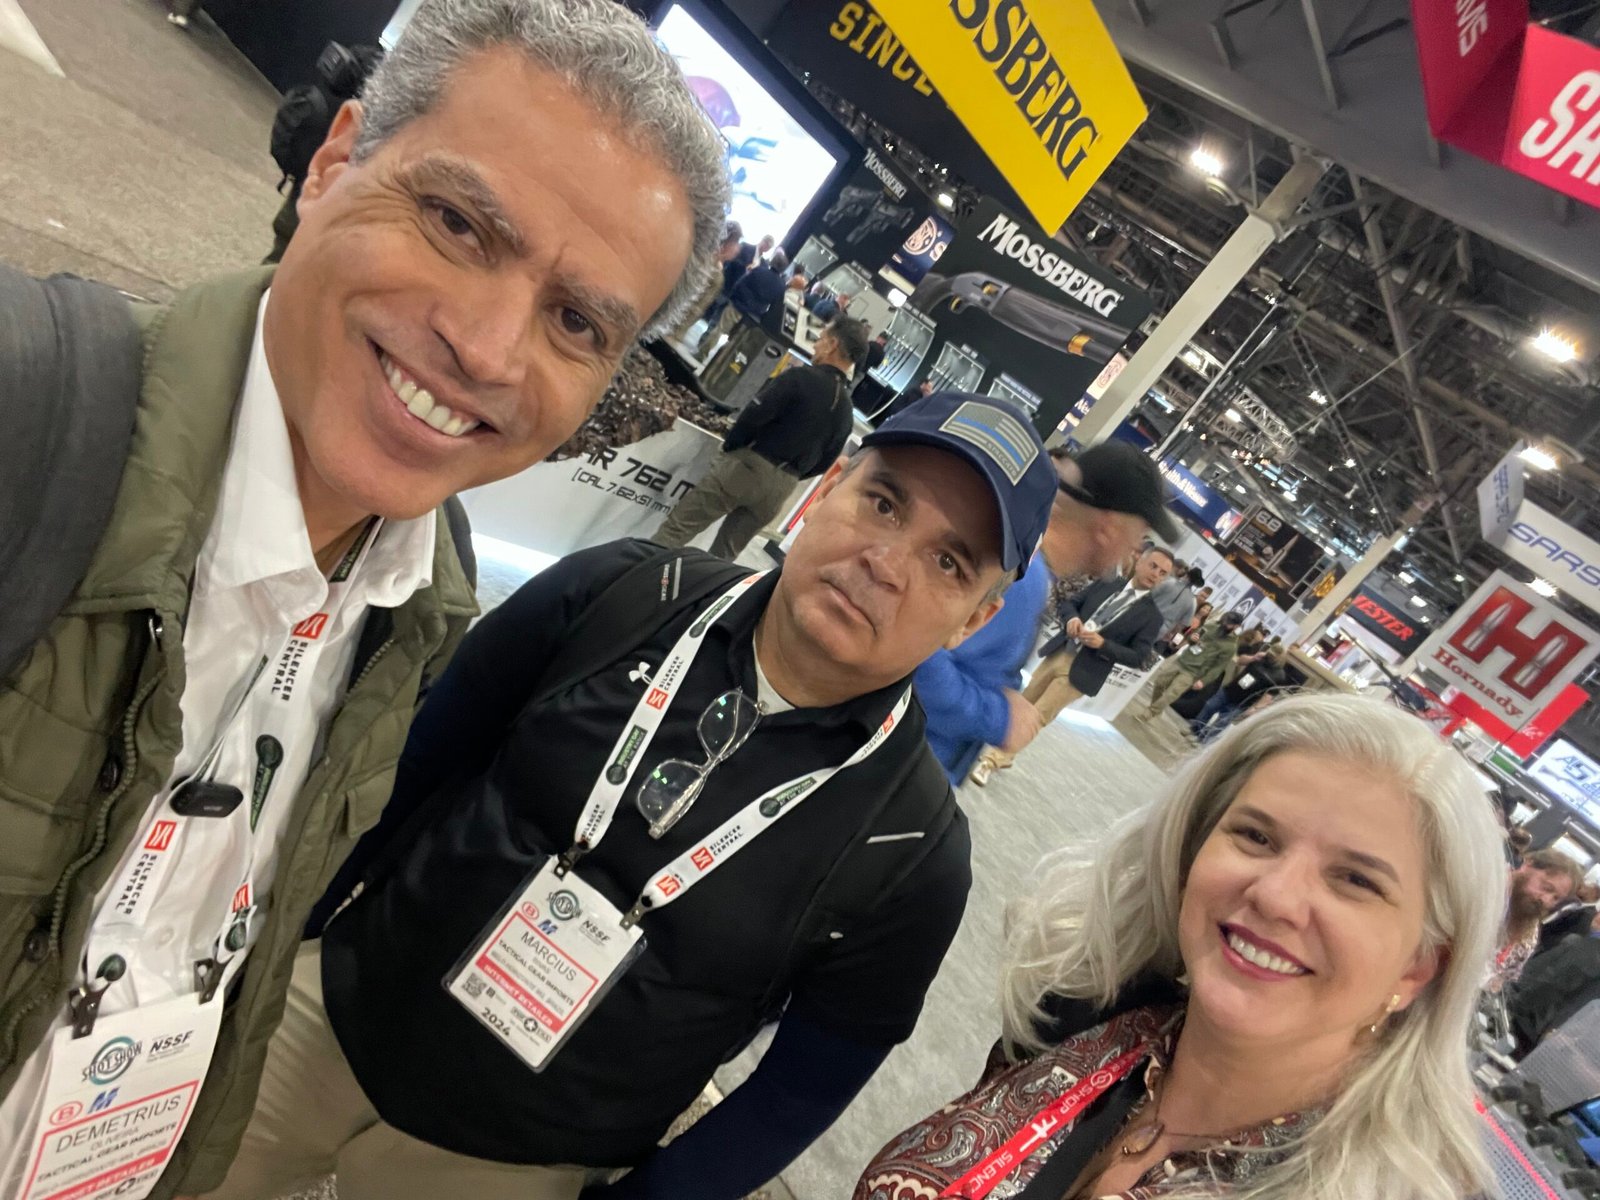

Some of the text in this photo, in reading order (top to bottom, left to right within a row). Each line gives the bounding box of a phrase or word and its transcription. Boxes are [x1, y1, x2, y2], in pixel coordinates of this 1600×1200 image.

[1519, 69, 1600, 187] SA
[863, 147, 907, 200] MOSSBERG
[976, 213, 1124, 318] MOSSBERG
[619, 457, 673, 492] 762
[269, 638, 298, 696] CENTRAL
[281, 641, 309, 702] SILENCER
[659, 655, 681, 689] SILENCER
[662, 659, 685, 691] CENTRAL
[1431, 646, 1523, 720] Hornady
[709, 824, 742, 851] SILENCER
[712, 832, 745, 857] CENTRAL
[114, 852, 150, 912] CENTRAL
[122, 853, 158, 916] SILENCER
[520, 931, 577, 982] MARCIUS
[583, 920, 611, 943] NSSF
[483, 964, 519, 997] INTERNET
[518, 995, 554, 1027] RETAILER
[499, 939, 574, 1006] TACTICAL GEAR IMPORTS
[150, 1030, 193, 1054] NSSF
[481, 1006, 511, 1037] 2024
[81, 1053, 116, 1083] SHOT
[113, 1041, 144, 1068] SHOW
[55, 1095, 182, 1154] DEMETRIUS
[1059, 1085, 1094, 1115] SHOP
[36, 1156, 94, 1183] TACTICAL
[96, 1142, 129, 1162] GEAR
[129, 1121, 178, 1146] IMPORTS
[968, 1150, 1014, 1192] SILENC
